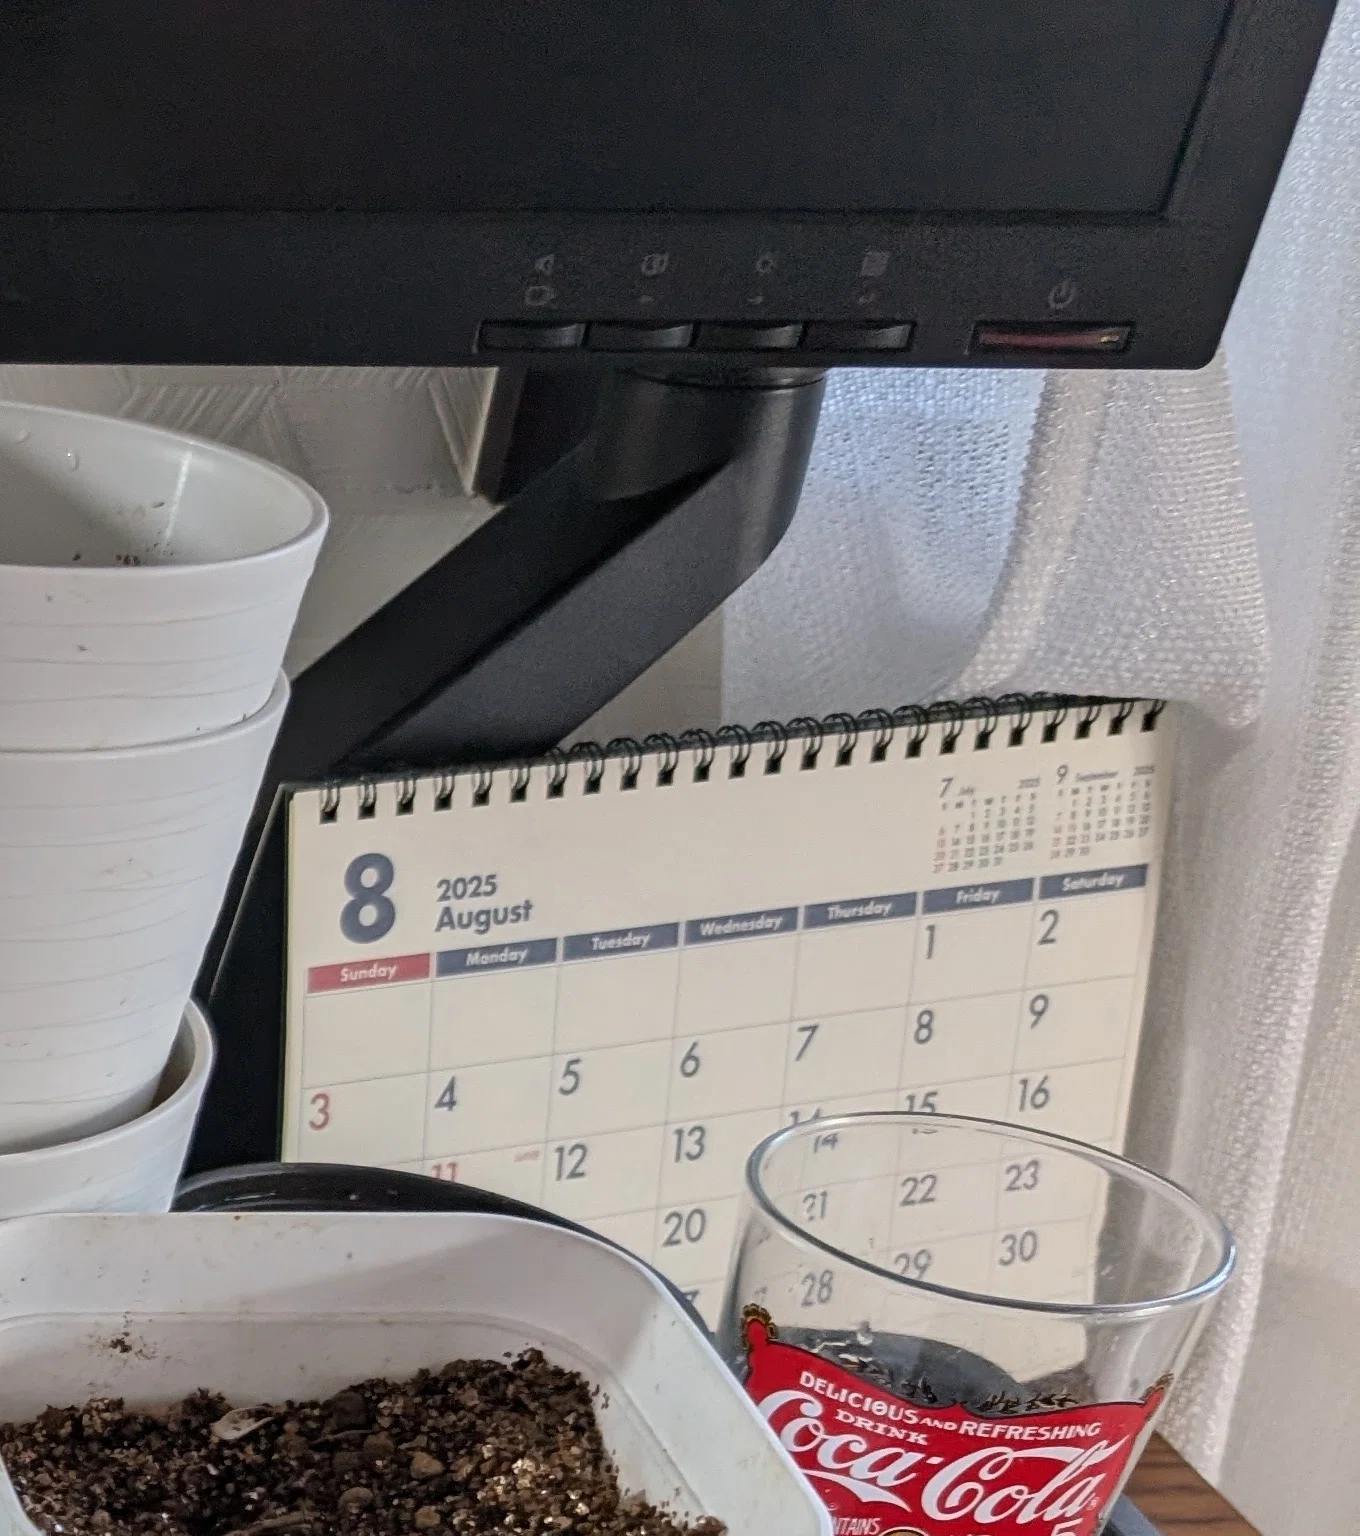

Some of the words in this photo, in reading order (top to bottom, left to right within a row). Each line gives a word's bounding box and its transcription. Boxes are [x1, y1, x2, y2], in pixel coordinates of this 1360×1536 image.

[939, 778, 954, 797] 7
[1057, 765, 1067, 785] 9
[339, 853, 396, 944] 8
[435, 900, 533, 934] August
[436, 873, 498, 902] 2025
[340, 963, 398, 983] Sunday
[466, 946, 529, 967] Monday
[591, 931, 651, 950] Tuesday
[700, 914, 783, 937] Wednesday
[827, 901, 892, 919] Thursday
[956, 888, 1000, 904] Friday
[1062, 871, 1125, 892] Saturday
[923, 924, 937, 960] 1
[1037, 909, 1058, 945] 2
[308, 1093, 330, 1131] 3
[434, 1075, 458, 1112] 4
[559, 1058, 582, 1096] 5
[680, 1041, 701, 1078] 6
[796, 1024, 819, 1062] 7
[913, 1010, 935, 1045] 8
[1029, 994, 1049, 1028] 9
[555, 1143, 588, 1182] 12
[674, 1125, 706, 1163] 13
[1018, 1075, 1050, 1111] 16
[662, 1208, 707, 1248] 20
[899, 1174, 937, 1207] 22
[1005, 1159, 1040, 1191] 23
[800, 1269, 835, 1308] 28
[893, 1249, 931, 1280] 29
[998, 1230, 1039, 1266] 30
[799, 1370, 919, 1425] DELICIOUS
[918, 1416, 958, 1431] AND
[958, 1420, 1102, 1441] REFRESHING
[834, 1408, 929, 1446] DRINK
[758, 1389, 1130, 1525] Coca-Cola
